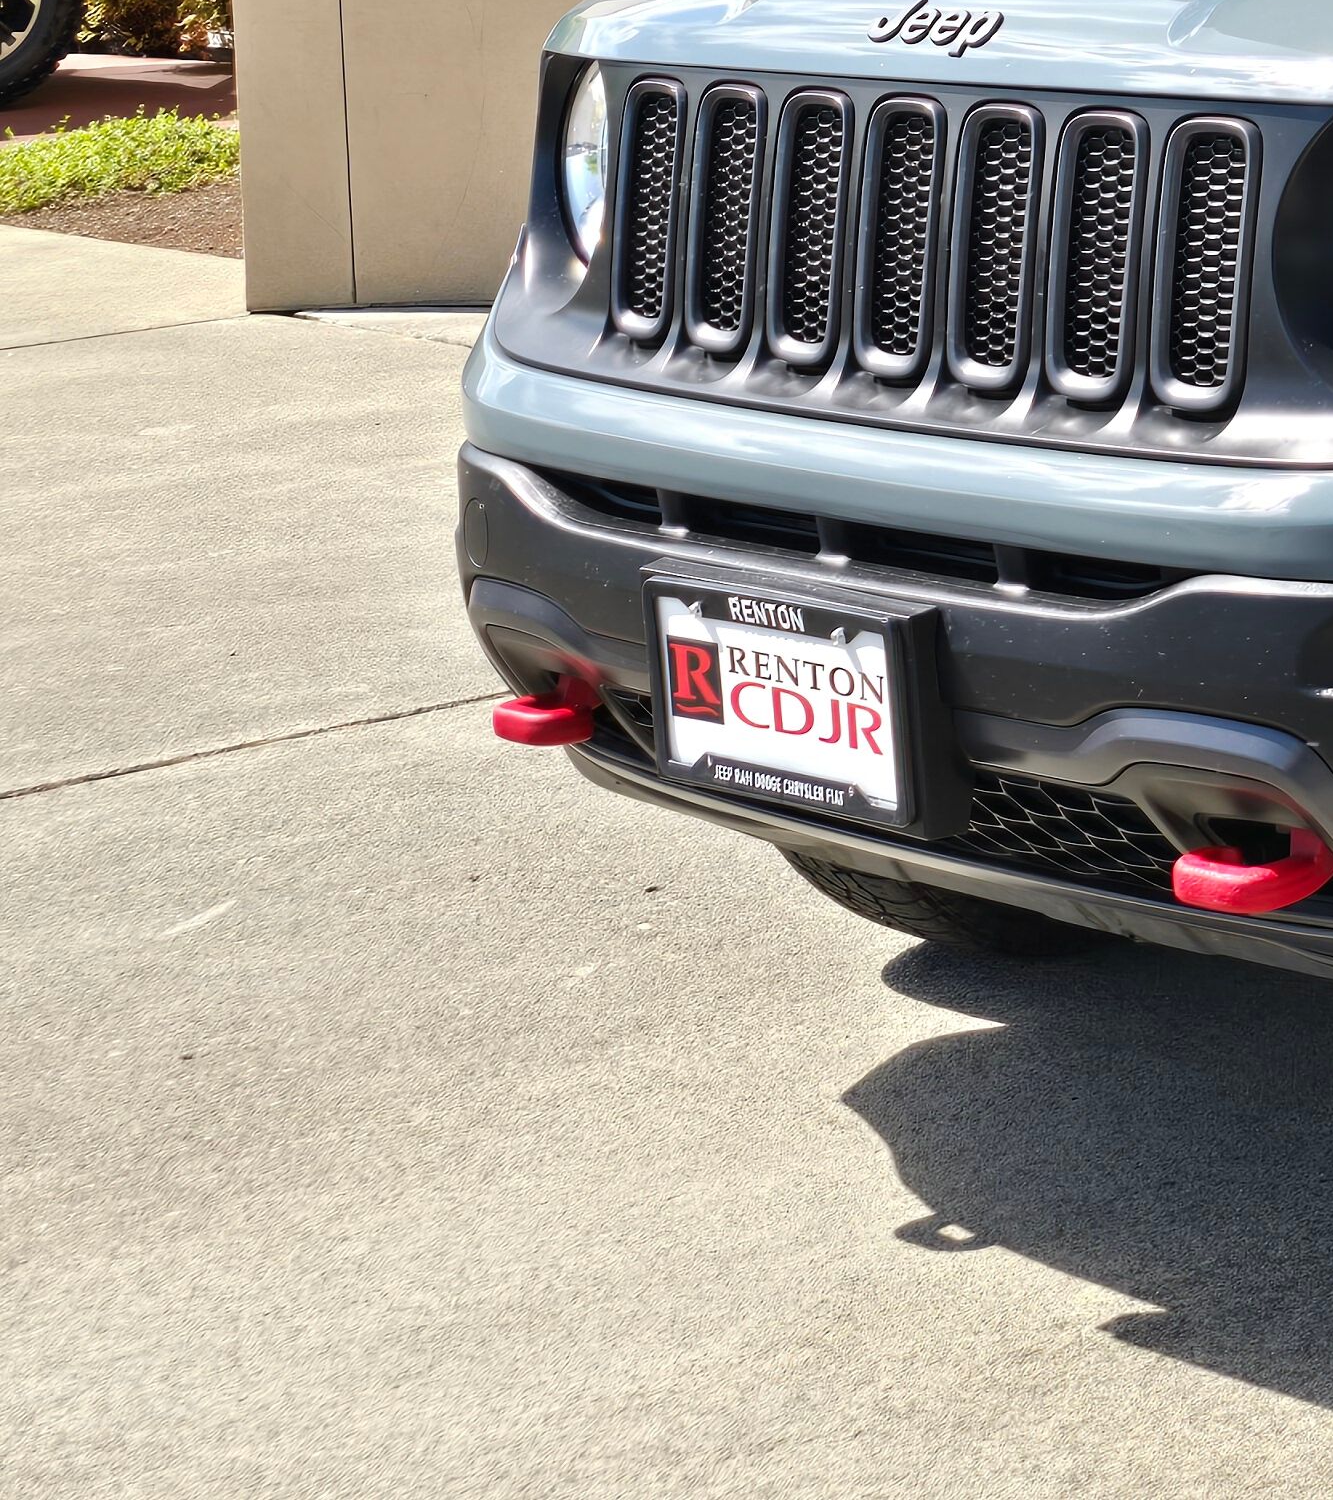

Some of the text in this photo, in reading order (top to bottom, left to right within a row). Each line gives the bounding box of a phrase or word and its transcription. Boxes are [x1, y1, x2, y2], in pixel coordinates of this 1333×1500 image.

[727, 596, 805, 632] RENTON
[669, 642, 721, 705] R
[726, 646, 885, 705] RENTON
[731, 681, 884, 757] CDJR
[714, 764, 733, 781] JEEP
[754, 772, 781, 793] DODGE
[783, 778, 824, 802] CHRYSLER
